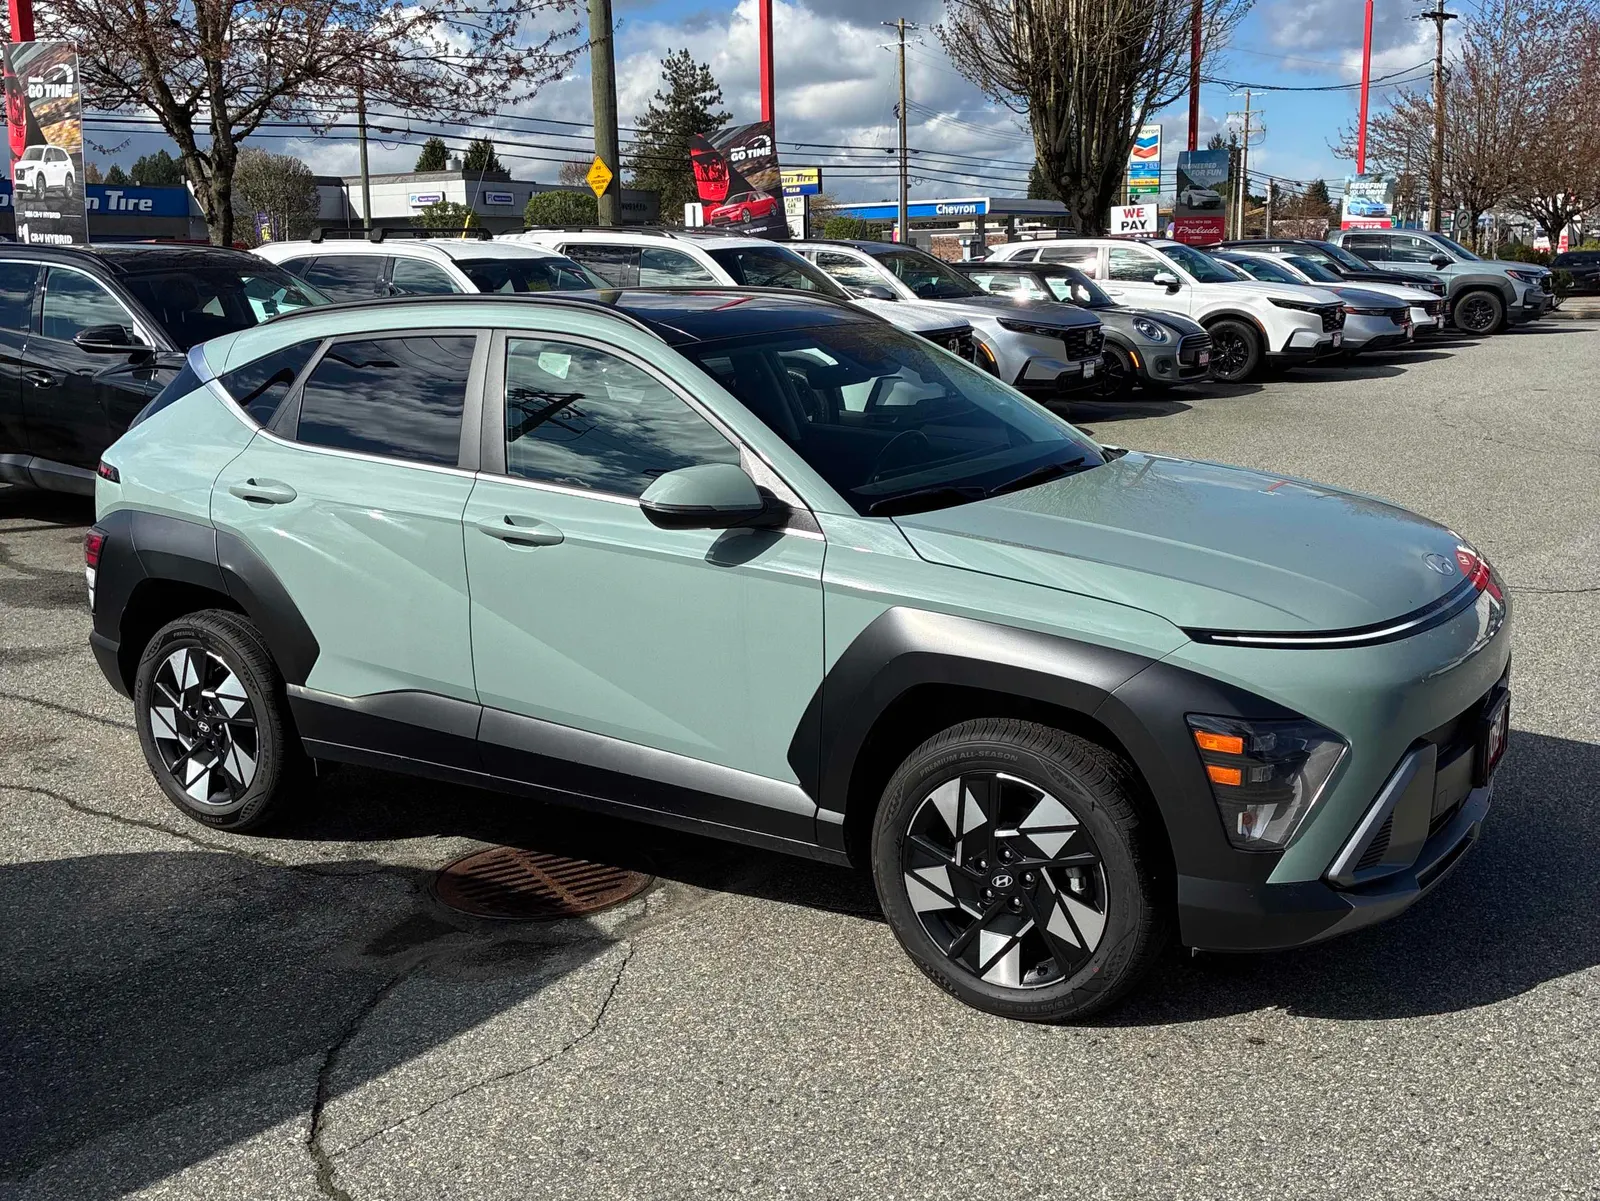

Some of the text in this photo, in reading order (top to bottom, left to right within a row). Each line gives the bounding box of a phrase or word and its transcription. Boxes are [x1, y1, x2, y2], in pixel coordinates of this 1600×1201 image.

[28, 84, 73, 98] GO TIME
[731, 147, 771, 161] GO TIME
[105, 190, 153, 211] Tire
[935, 203, 976, 215] Chevron
[1123, 207, 1145, 218] WE
[1121, 220, 1147, 231] PAY
[1177, 226, 1220, 234] Prelude
[30, 232, 45, 243] CR-V
[45, 233, 73, 245] HYBRID
[919, 750, 1019, 777] PREMIUM ALL-SEASON
